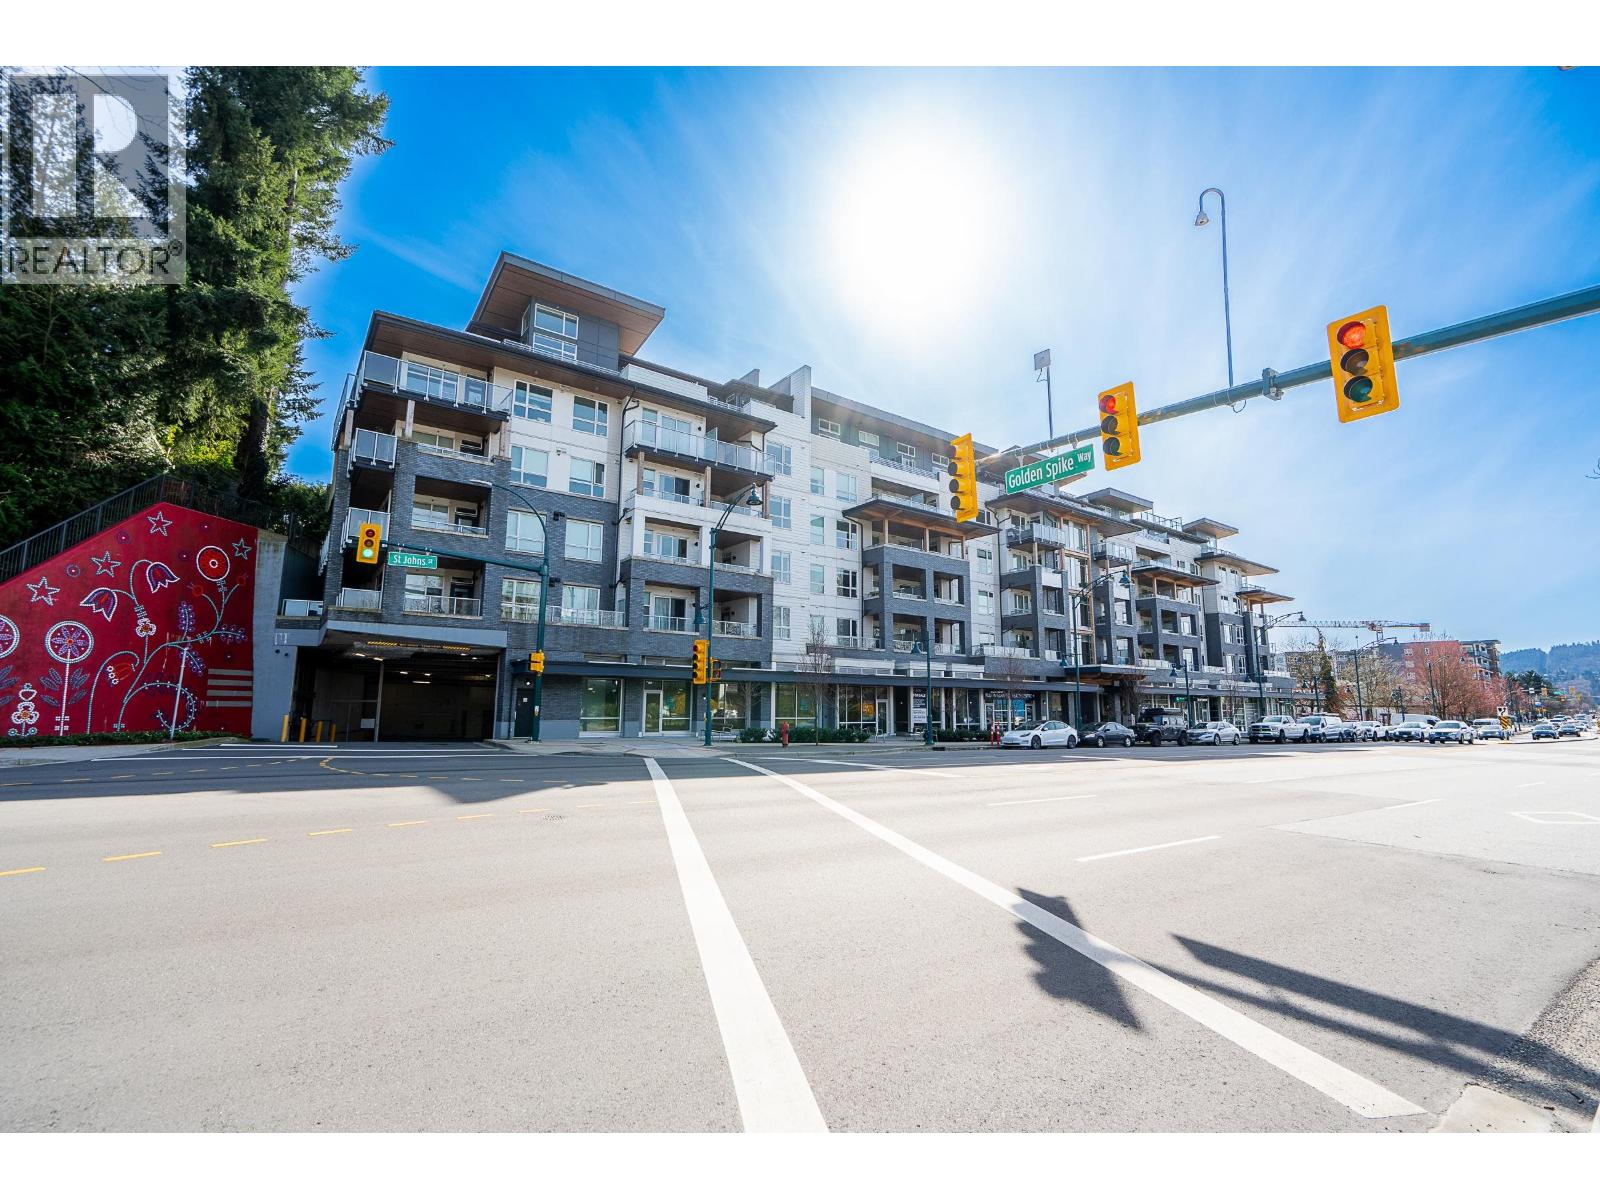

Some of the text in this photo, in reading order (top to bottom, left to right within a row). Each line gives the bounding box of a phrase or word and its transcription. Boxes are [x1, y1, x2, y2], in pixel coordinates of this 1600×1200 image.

[1008, 451, 1092, 488] Golden Spike Way
[393, 554, 402, 564] St
[403, 555, 426, 566] Johns
